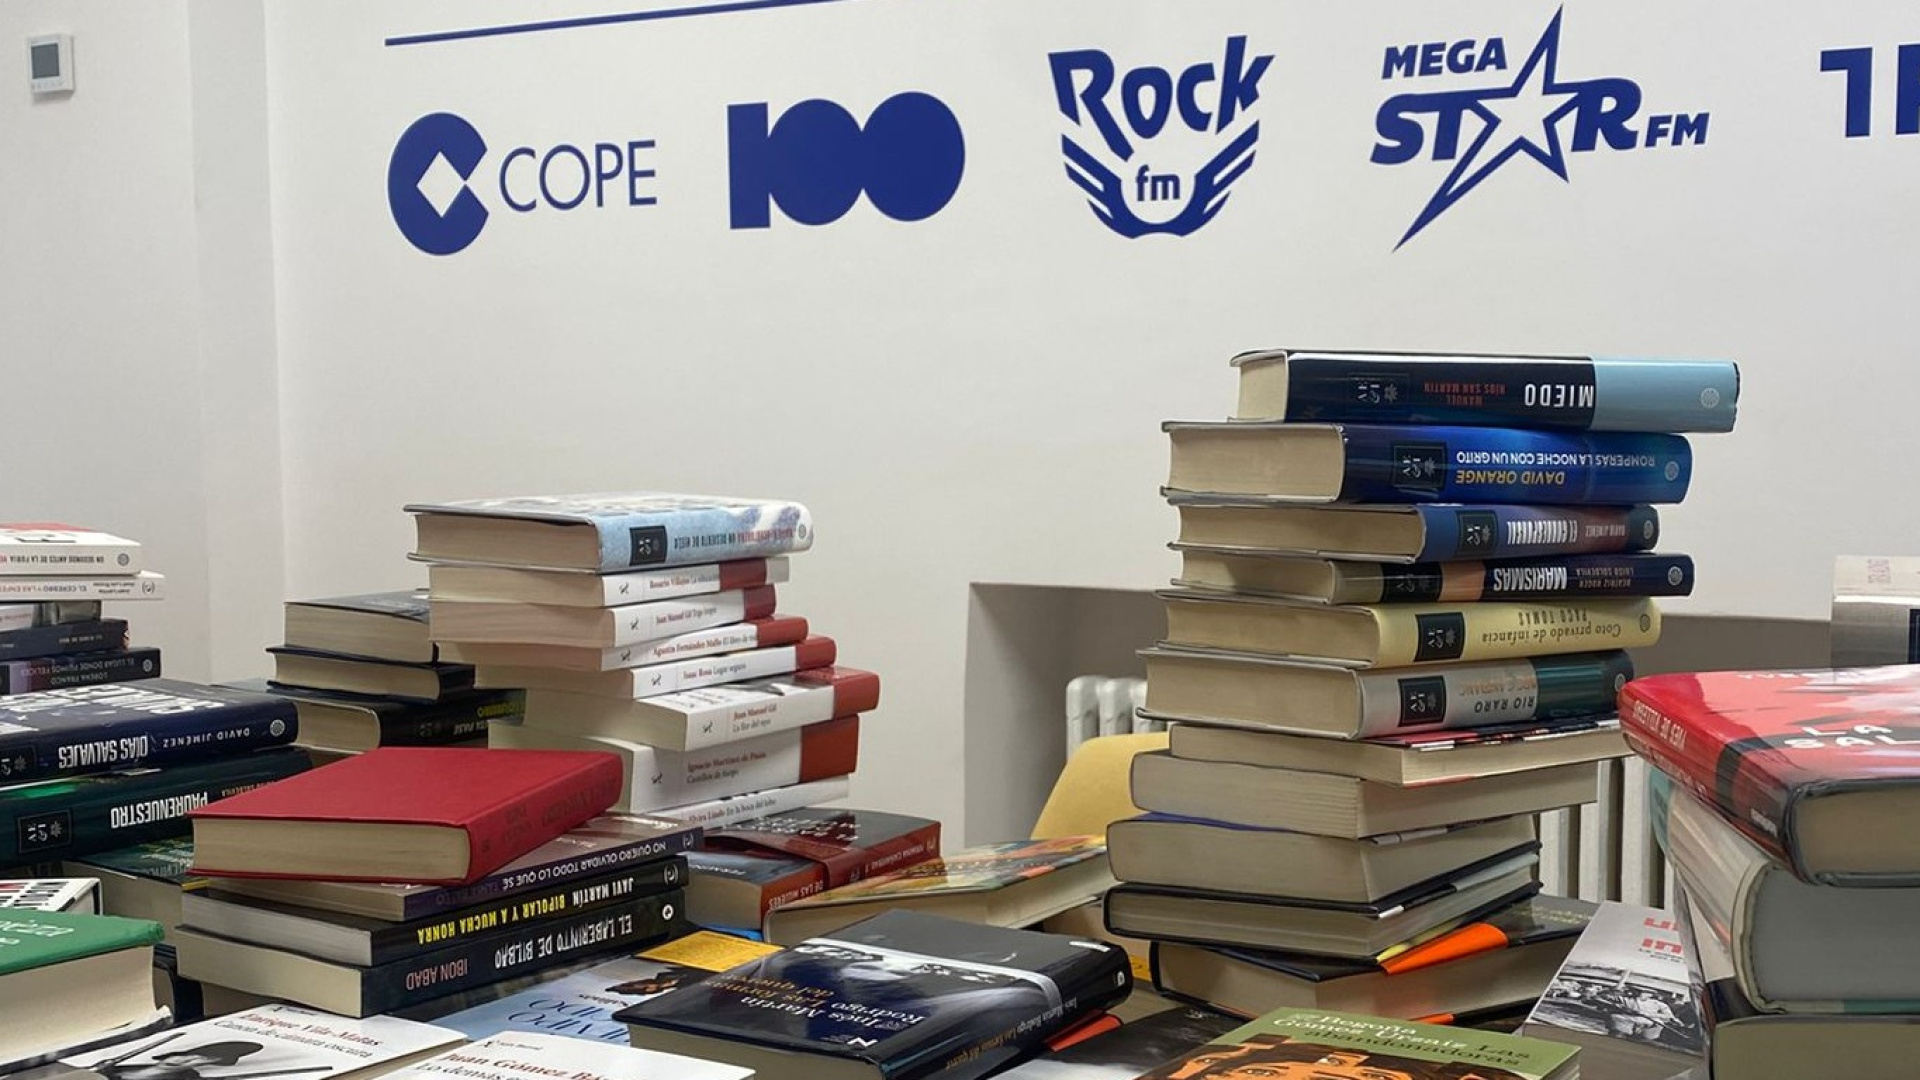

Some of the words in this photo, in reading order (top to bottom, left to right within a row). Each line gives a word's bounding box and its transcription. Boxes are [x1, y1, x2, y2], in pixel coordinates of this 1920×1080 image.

[1381, 37, 1508, 80] MEGA
[1047, 34, 1276, 162] Rock
[1644, 112, 1710, 149] FM
[726, 90, 967, 231] 100
[499, 139, 658, 213] COPE
[1136, 165, 1181, 202] fm
[1524, 383, 1595, 408] MIEDO
[1455, 450, 1491, 463] GRITO
[1491, 451, 1510, 464] UN
[1511, 451, 1536, 464] CON
[1536, 452, 1579, 465] NOCHE
[1579, 454, 1593, 465] LA
[1595, 454, 1656, 469] ROMPERÁS
[1455, 470, 1518, 484] ORANGE
[1521, 470, 1566, 485] DAVID
[1493, 566, 1568, 591] MARISMAS
[1559, 609, 1588, 623] PACO
[1482, 630, 1530, 644] infancia
[1533, 628, 1547, 641] de
[1550, 620, 1592, 639] privado
[1594, 623, 1622, 638] Coto
[733, 711, 746, 720] Juan
[747, 706, 769, 718] Manuel
[769, 704, 777, 714] Gil
[1474, 700, 1509, 713] RARO
[733, 722, 740, 732] La
[1801, 723, 1893, 738] LA
[163, 732, 212, 749] JIMÉNEZ
[217, 727, 250, 747] DAVID
[1784, 735, 1920, 749] SAL
[58, 740, 117, 769] SALVAJES
[120, 735, 148, 763] DÍAS
[618, 843, 652, 862] QUIERO
[653, 840, 667, 852] NO
[553, 860, 580, 877] TODO
[580, 850, 618, 871] OLVIDAR
[516, 870, 538, 886] QUE
[537, 866, 552, 880] LO
[572, 882, 610, 908] MARTÍN
[611, 877, 635, 897] JAVI
[500, 908, 509, 924] A
[511, 907, 519, 923] Y
[523, 893, 566, 920] BIPOLAR
[417, 920, 456, 945] HONRA
[459, 911, 497, 935] MUCHA
[619, 913, 634, 935] EL
[557, 919, 616, 952] LABERINTO
[494, 940, 535, 970] BILBAO
[537, 935, 553, 959] DE
[405, 967, 439, 992] ABAD
[441, 958, 469, 982] IBON
[831, 1001, 925, 1025] Rodrigo
[1473, 1041, 1531, 1060] Las
